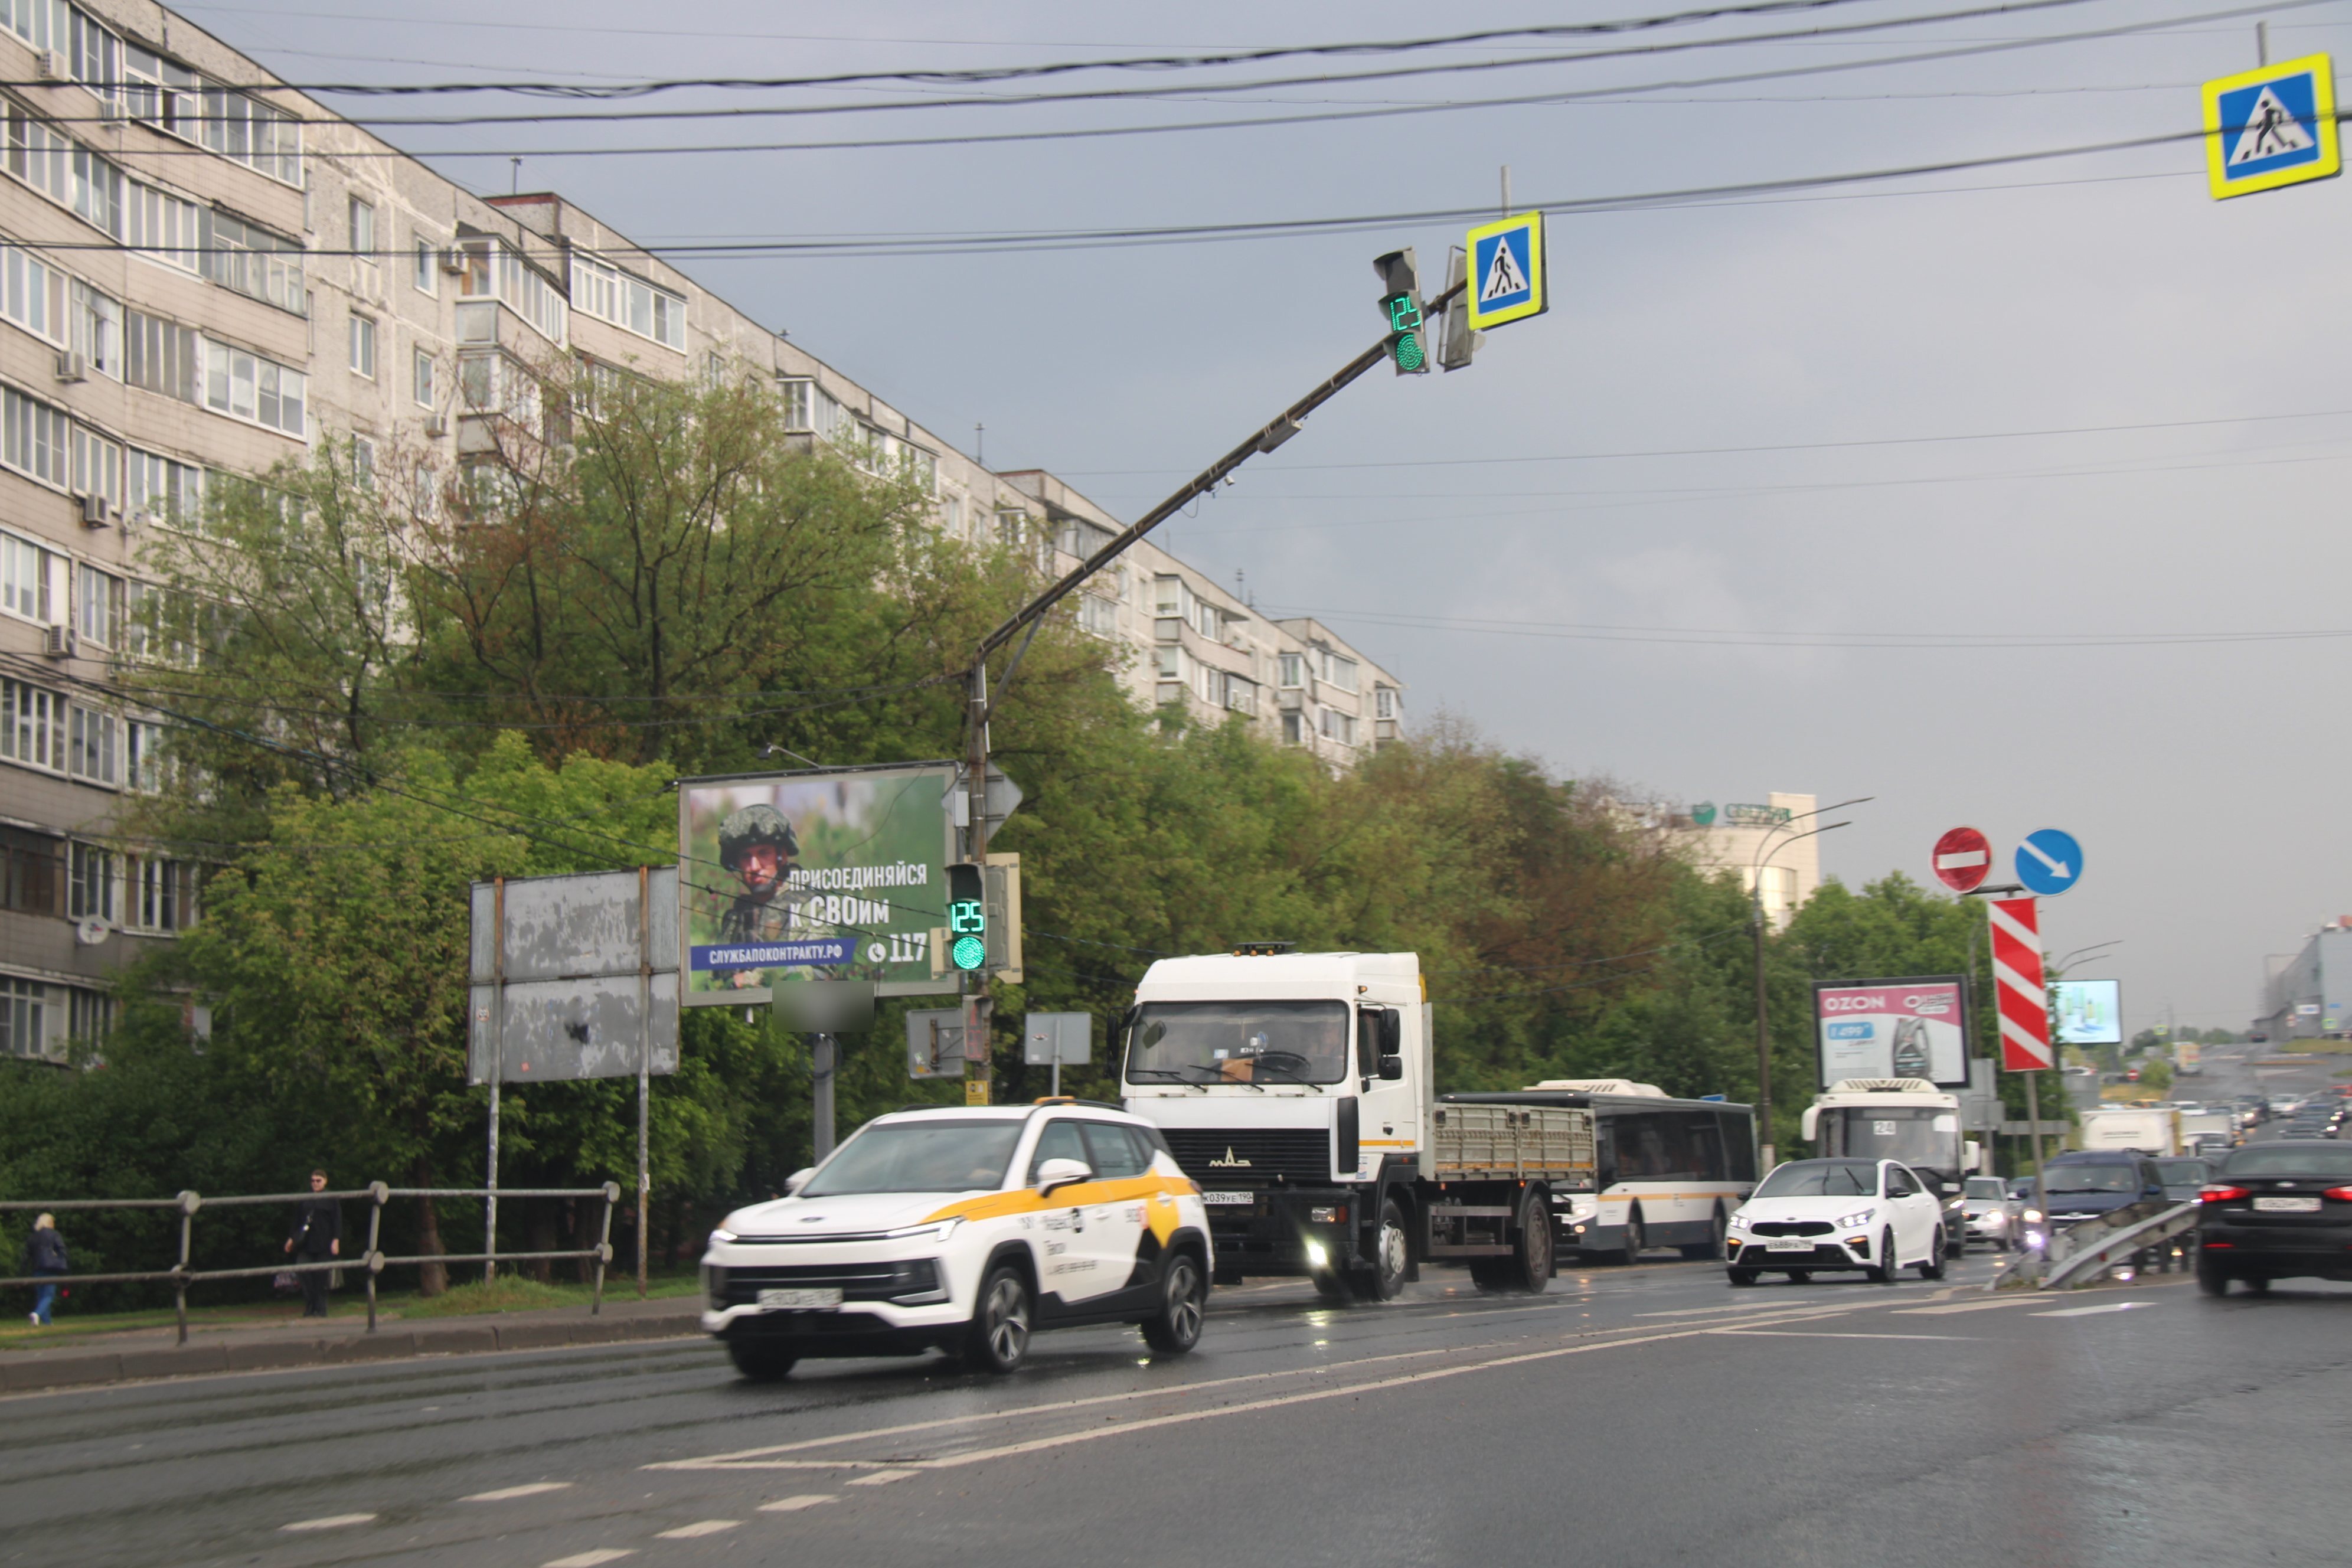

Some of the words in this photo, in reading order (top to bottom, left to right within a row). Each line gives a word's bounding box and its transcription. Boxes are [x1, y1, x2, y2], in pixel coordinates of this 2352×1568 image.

[1390, 296, 1421, 331] 125
[789, 860, 927, 891] ПРИСОЕДИНЯЙСЯ
[951, 902, 984, 932] 125
[709, 943, 843, 964] СЛУЖБАПОКОНТРАКТУ.РФ
[889, 932, 927, 963] 117
[1824, 995, 1885, 1011] OZON
[1876, 1122, 1894, 1133] 24
